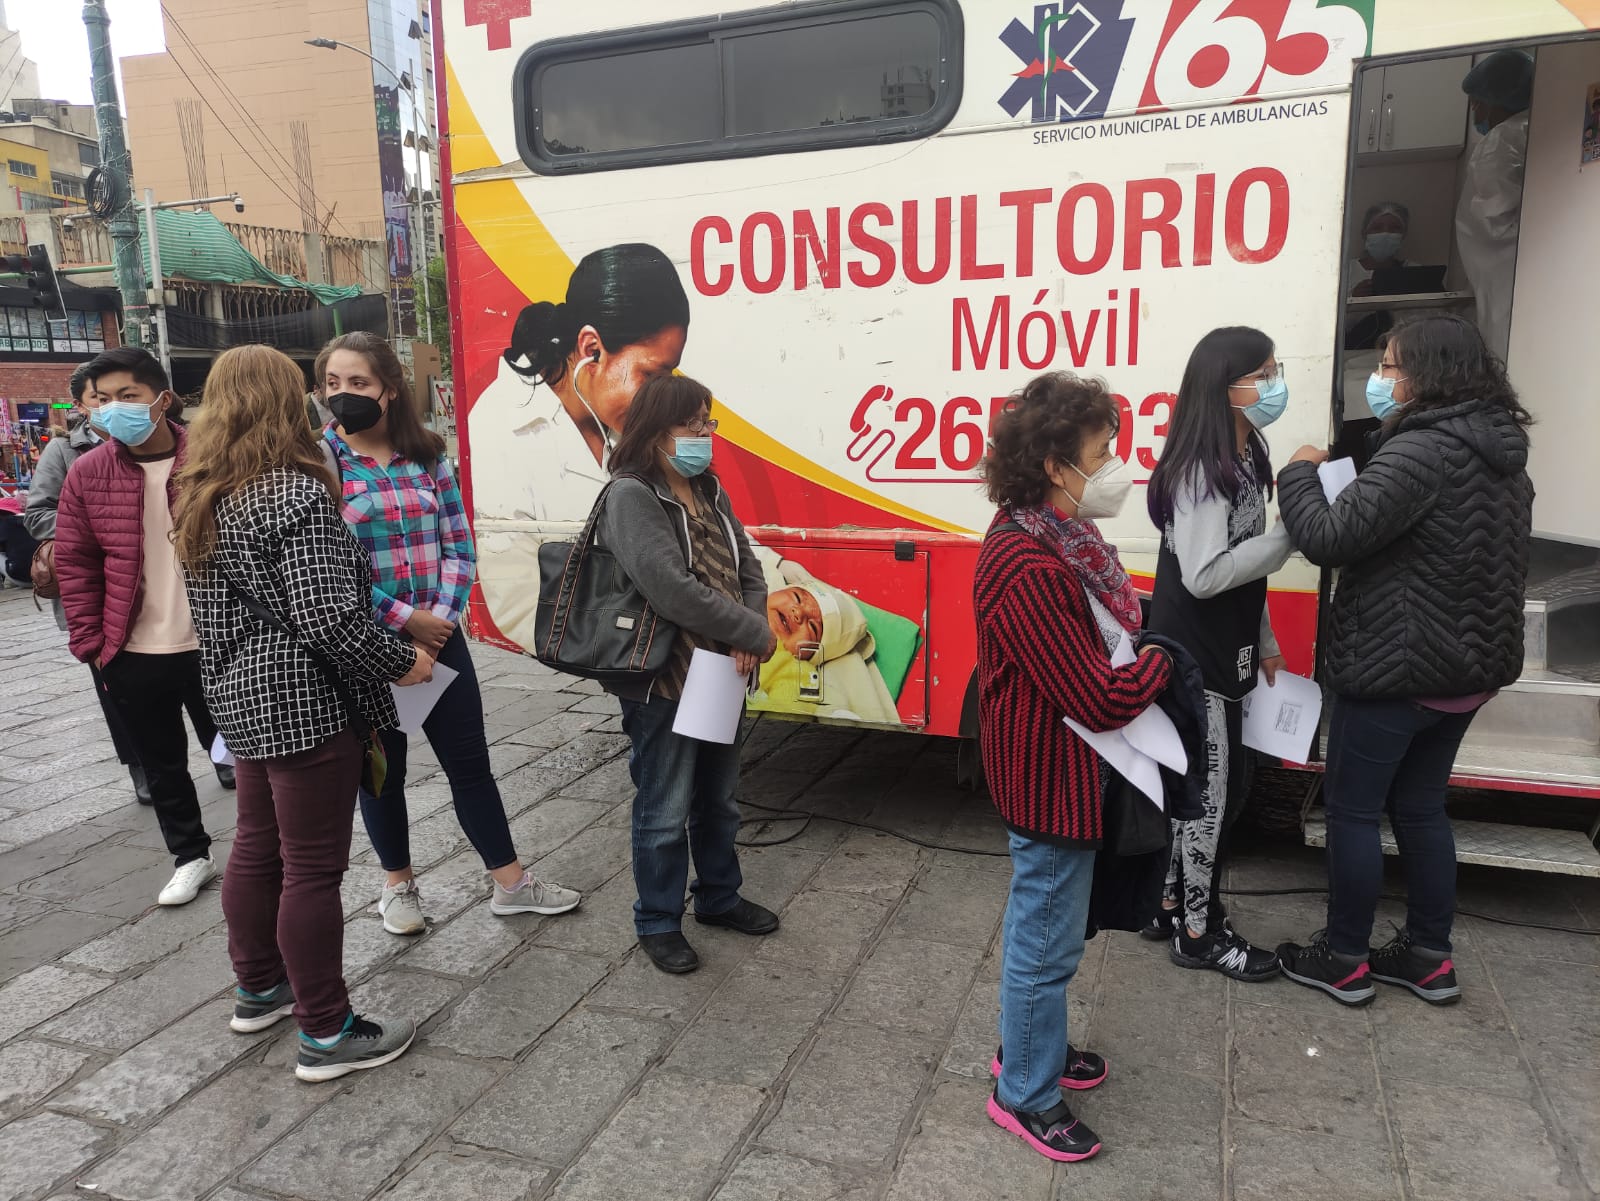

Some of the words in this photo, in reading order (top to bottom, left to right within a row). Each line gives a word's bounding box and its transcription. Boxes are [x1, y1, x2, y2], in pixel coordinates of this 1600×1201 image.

[1103, 0, 1368, 114] 165
[1033, 125, 1097, 145] SERVICIO
[1100, 116, 1181, 138] MUNICIPAL
[1185, 114, 1206, 129] DE
[1210, 100, 1328, 128] AMBULANCIAS
[690, 166, 1291, 297] CONSULTORIO
[951, 287, 1140, 372] Móvil
